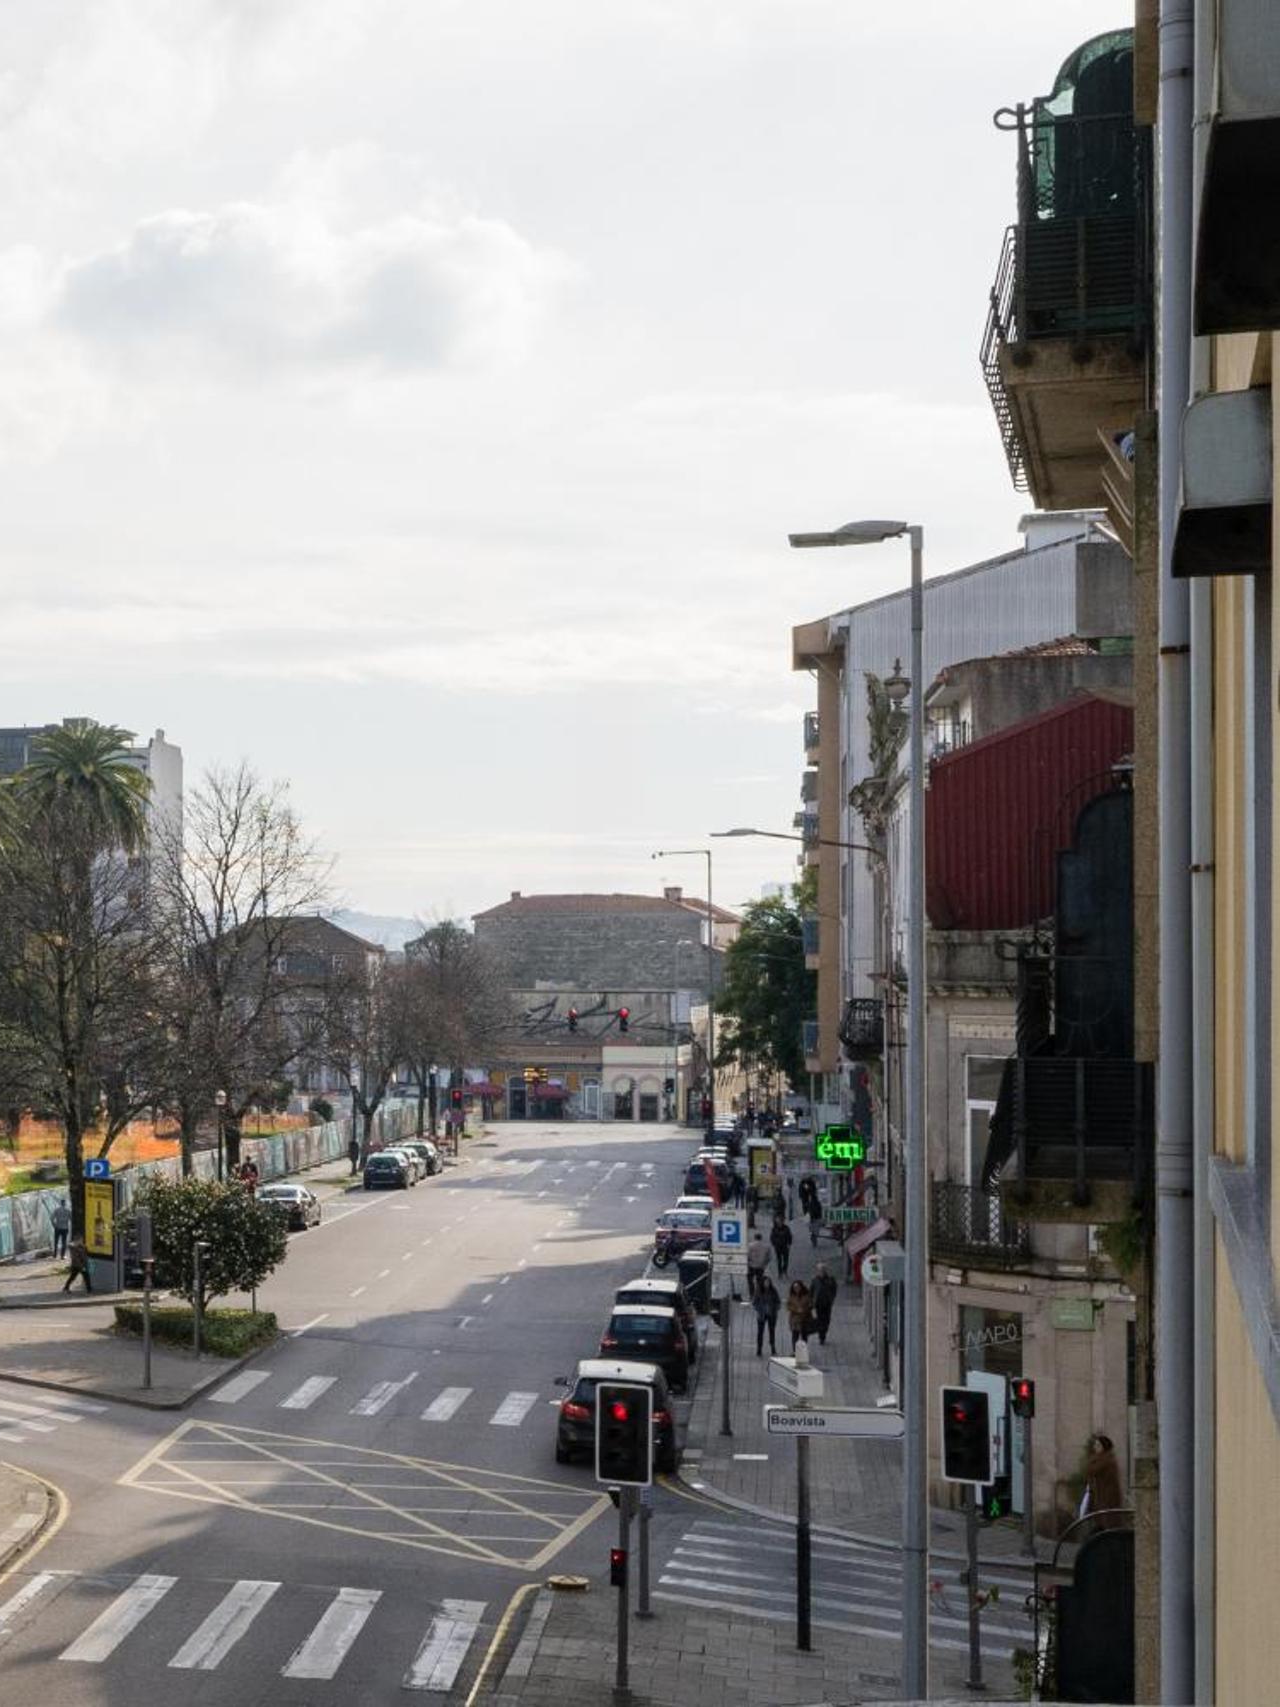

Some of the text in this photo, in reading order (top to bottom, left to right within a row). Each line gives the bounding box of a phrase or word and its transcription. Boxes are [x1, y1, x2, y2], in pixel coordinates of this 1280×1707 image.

[91, 1161, 104, 1176] P
[722, 1223, 736, 1241] P
[771, 1414, 825, 1427] Boavista
